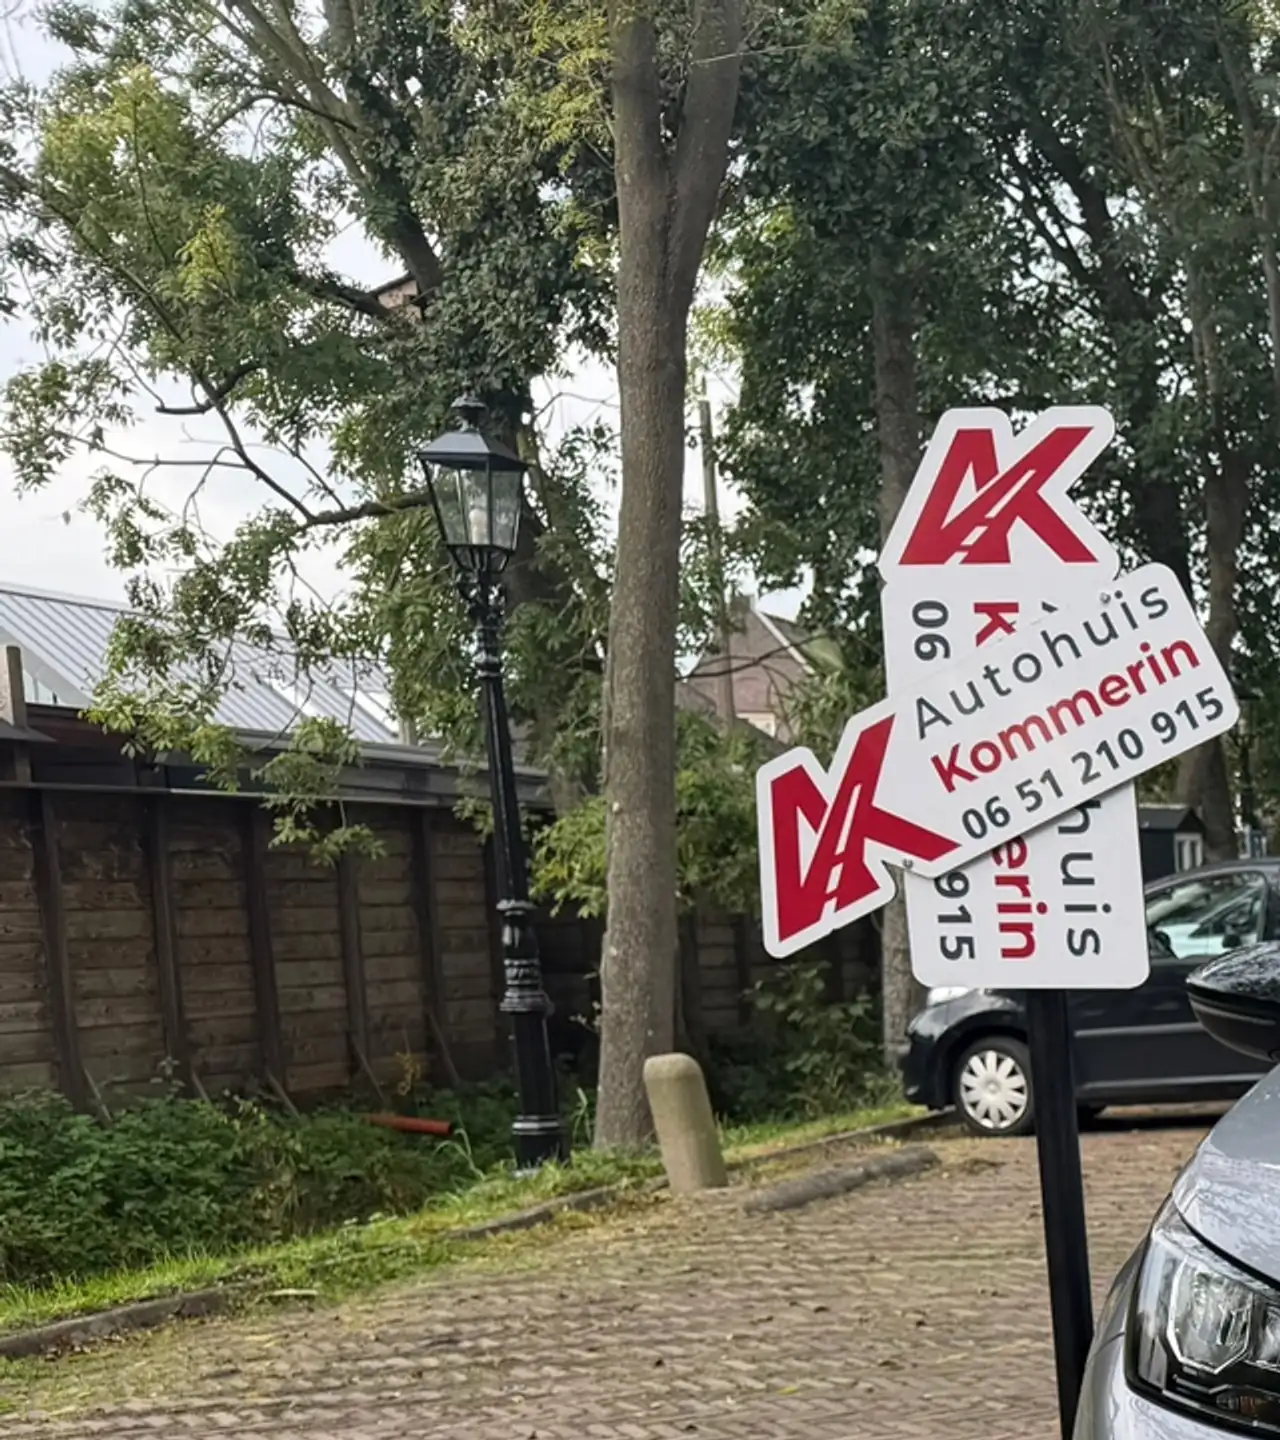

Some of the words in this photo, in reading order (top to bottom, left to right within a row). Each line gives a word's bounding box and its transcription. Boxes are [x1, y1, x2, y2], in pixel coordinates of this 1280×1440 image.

[912, 600, 951, 662] 06
[914, 586, 1169, 739] Autohuis
[931, 639, 1200, 793] Kommerin
[961, 796, 1011, 839] 06
[1014, 770, 1064, 813] 51
[1072, 728, 1144, 785] 210
[1150, 688, 1224, 744] 915
